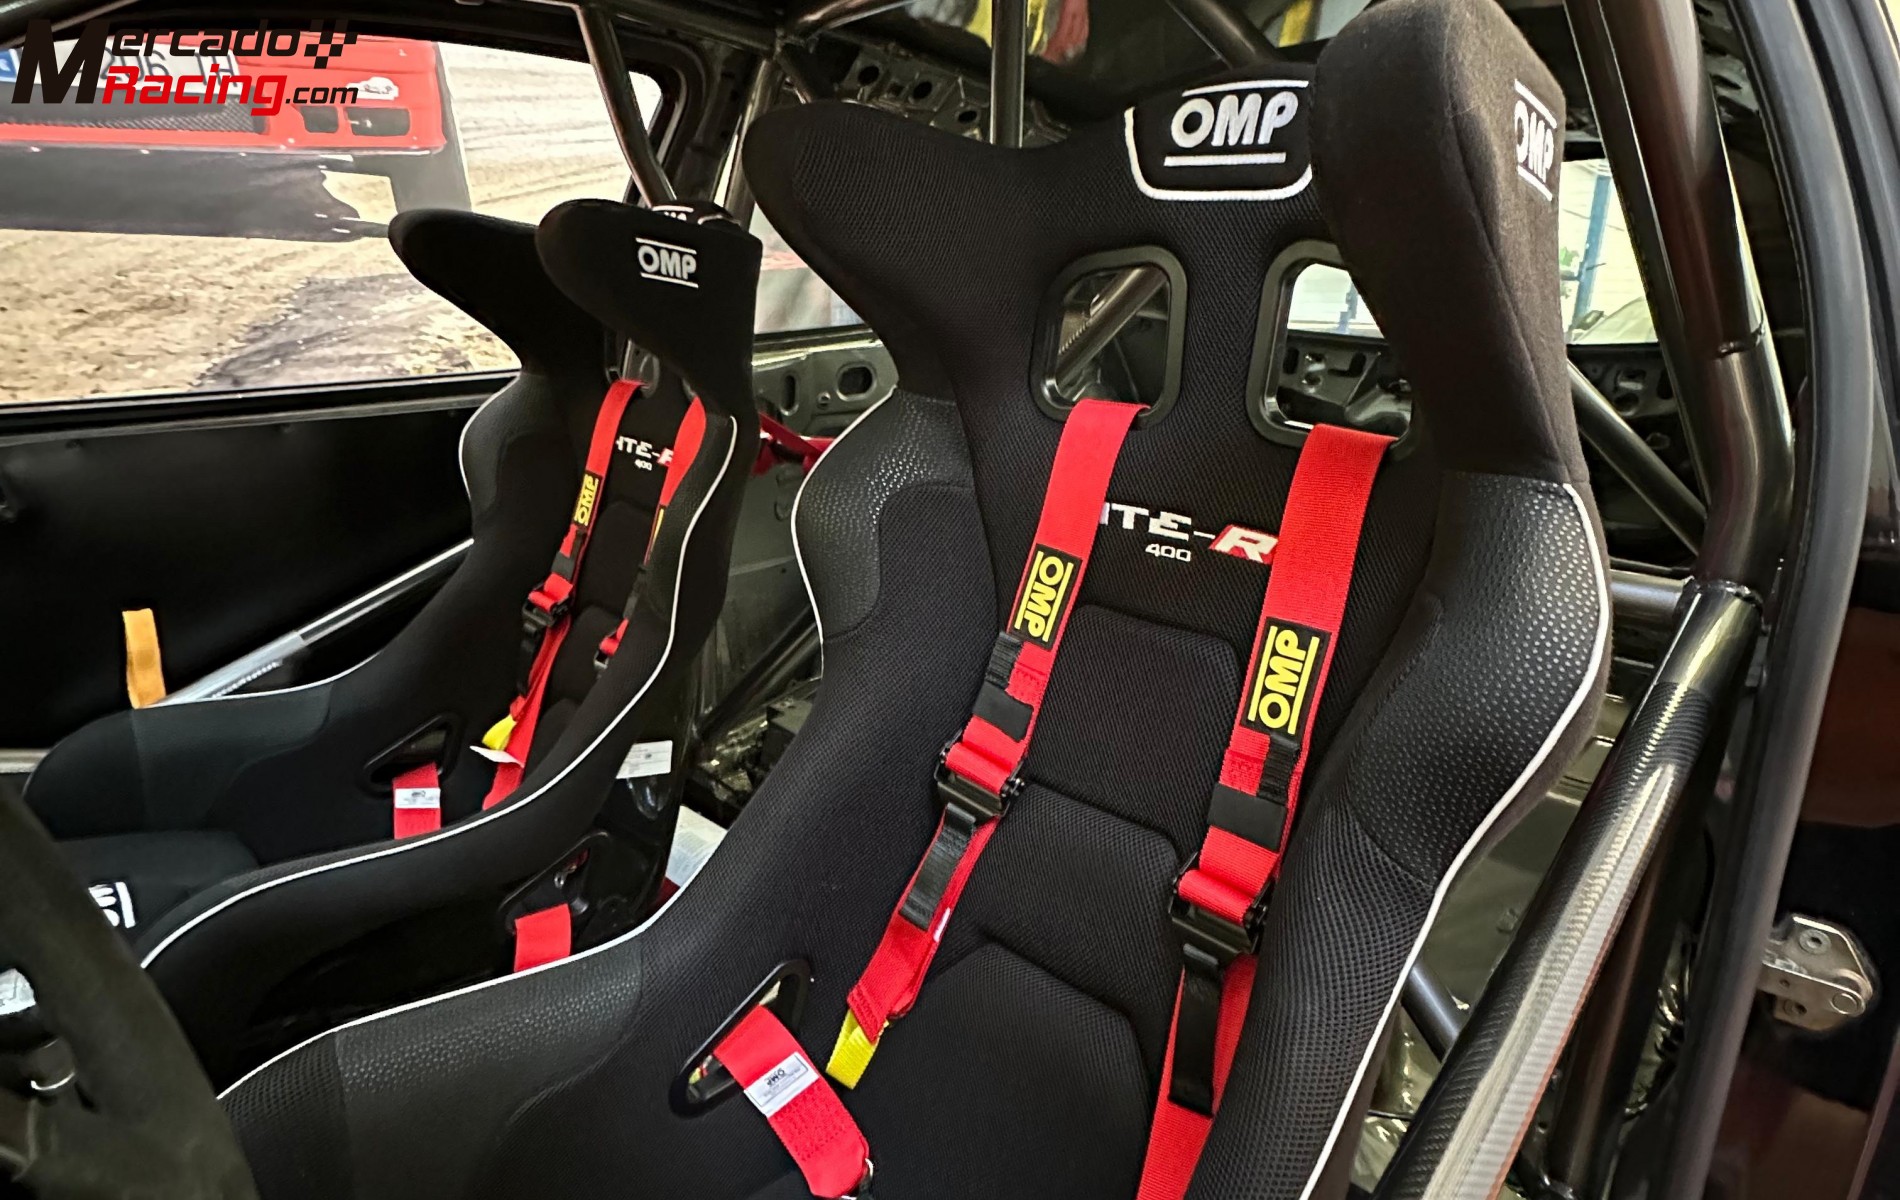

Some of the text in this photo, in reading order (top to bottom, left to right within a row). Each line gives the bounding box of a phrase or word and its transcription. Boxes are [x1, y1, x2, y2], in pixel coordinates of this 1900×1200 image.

[1171, 91, 1298, 149] OMP
[1514, 100, 1554, 183] OMP
[638, 245, 697, 280] OMP
[576, 475, 597, 525] OMP
[1100, 502, 1280, 564] TE-R
[1145, 543, 1192, 562] 400
[1024, 556, 1065, 638] OMP
[1258, 629, 1307, 729] OMP
